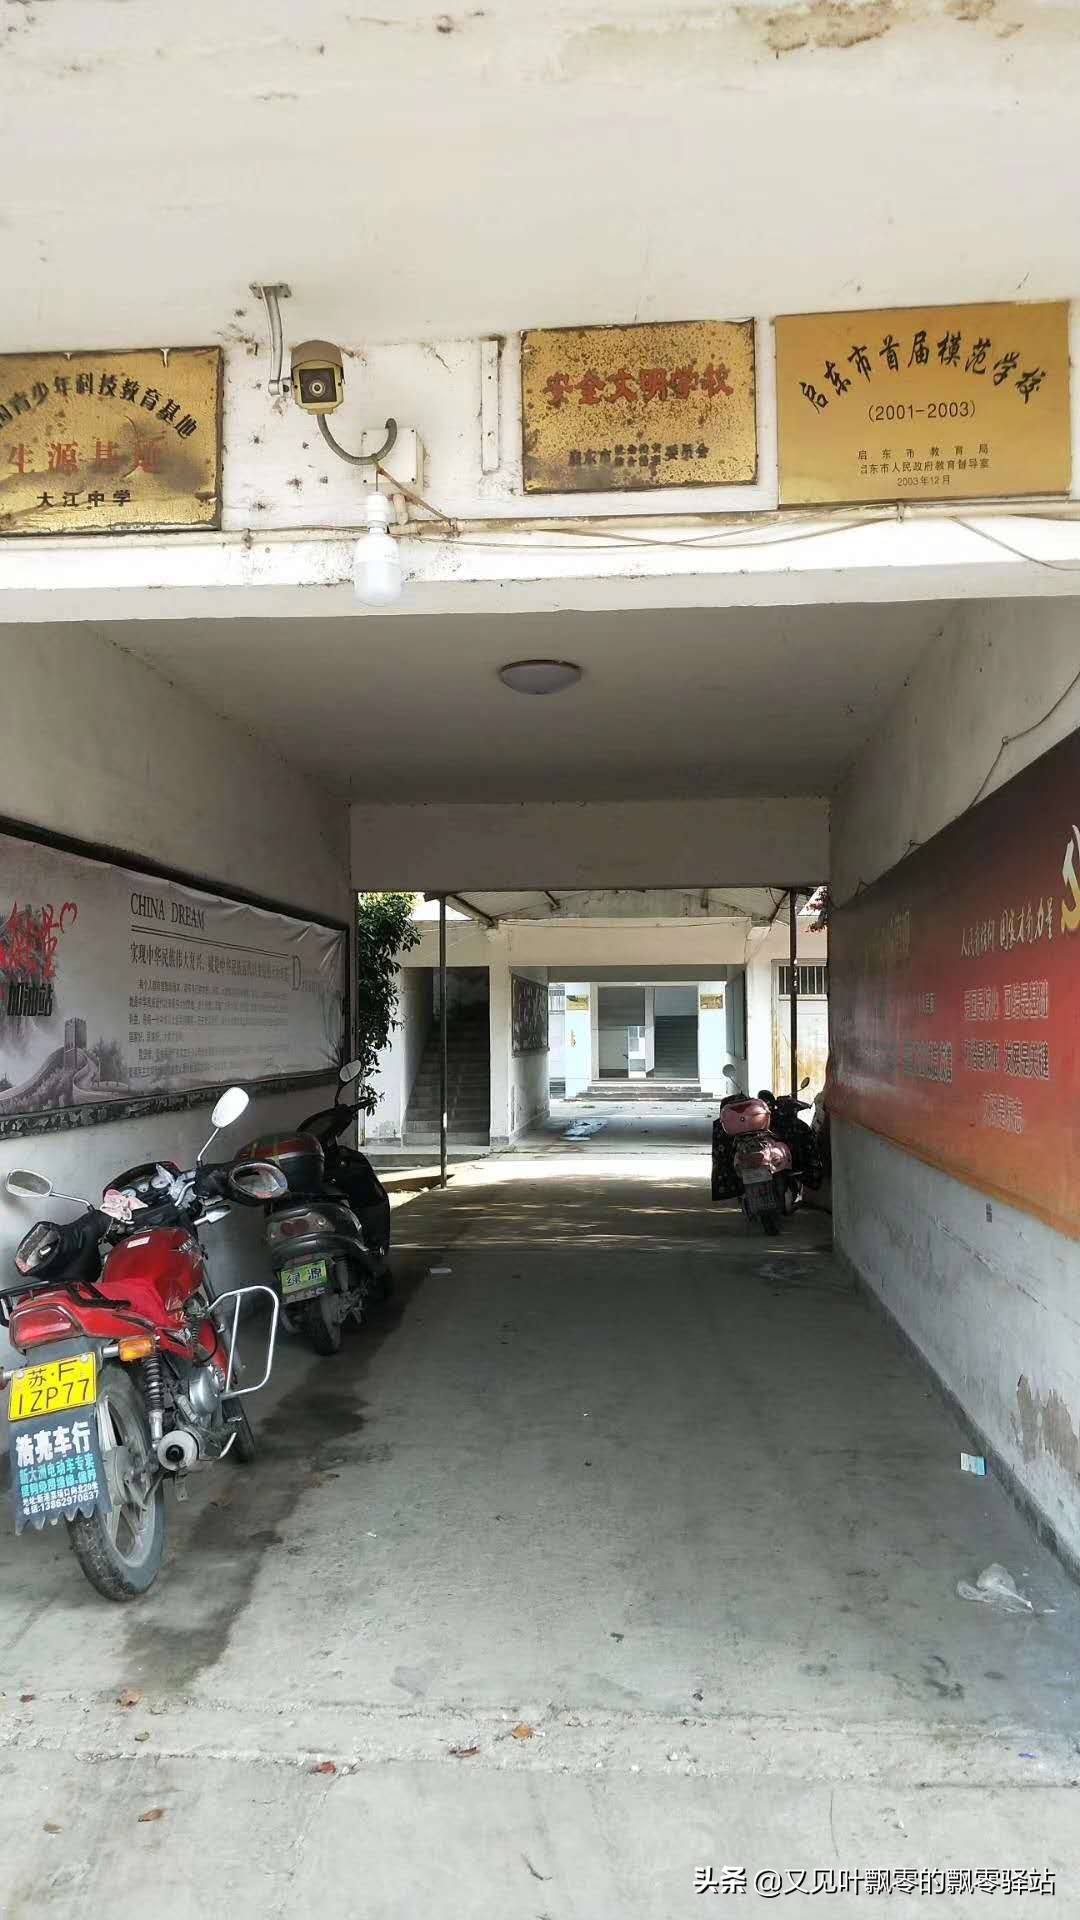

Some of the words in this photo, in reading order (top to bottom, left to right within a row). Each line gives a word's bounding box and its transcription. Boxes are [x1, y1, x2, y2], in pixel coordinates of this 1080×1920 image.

[799, 330, 1047, 414] 启东市首届模范学校
[868, 400, 976, 423] (2001-2003)
[37, 490, 131, 507] 大江中学
[131, 893, 165, 921] CHINA
[171, 902, 205, 930] DREAM
[28, 1360, 78, 1388] 苏·F
